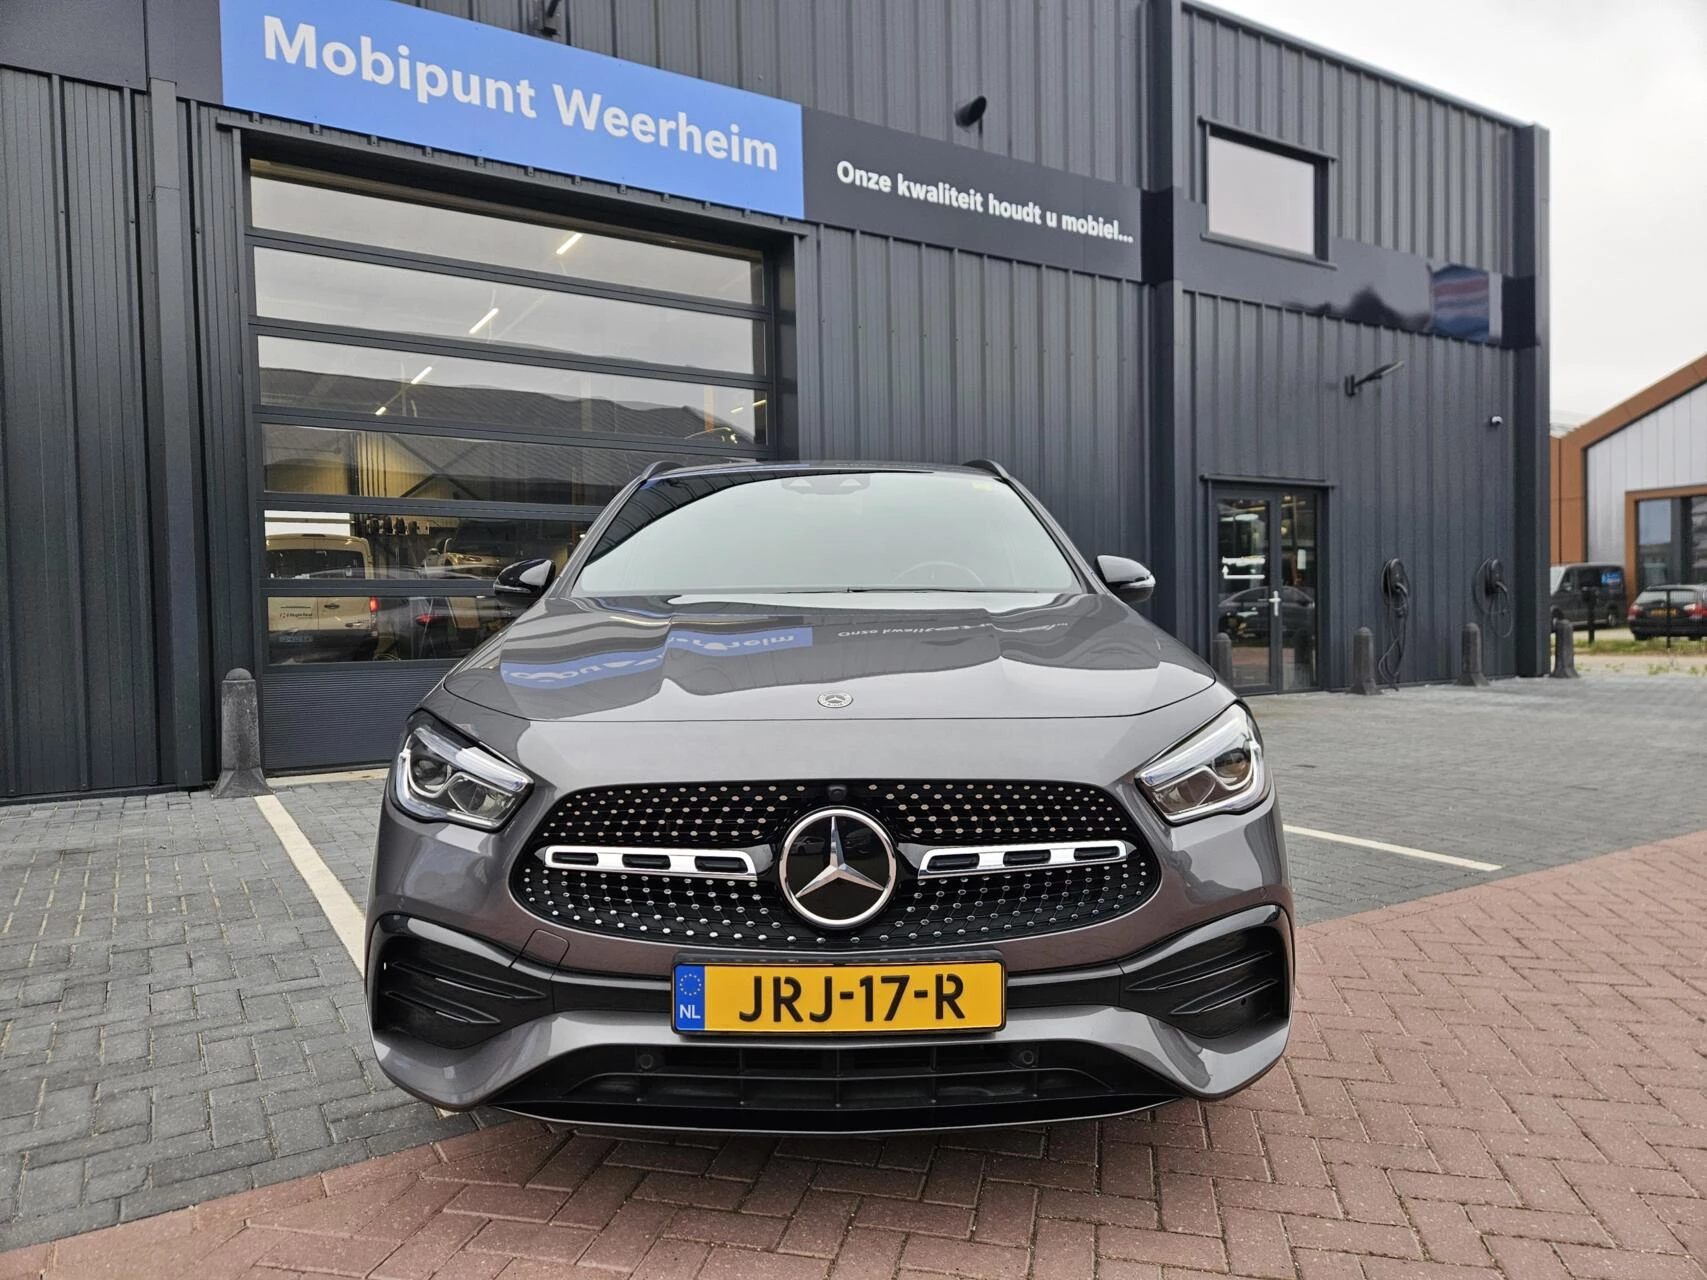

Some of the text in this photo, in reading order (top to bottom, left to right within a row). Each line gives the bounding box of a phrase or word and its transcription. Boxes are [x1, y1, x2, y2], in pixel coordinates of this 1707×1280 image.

[263, 15, 778, 171] Mobipunt Weerheim
[836, 160, 1134, 243] Onze kwaliteit houdt u mobiel...
[679, 1004, 701, 1020] NL
[738, 973, 966, 1022] JRJ-17-R
